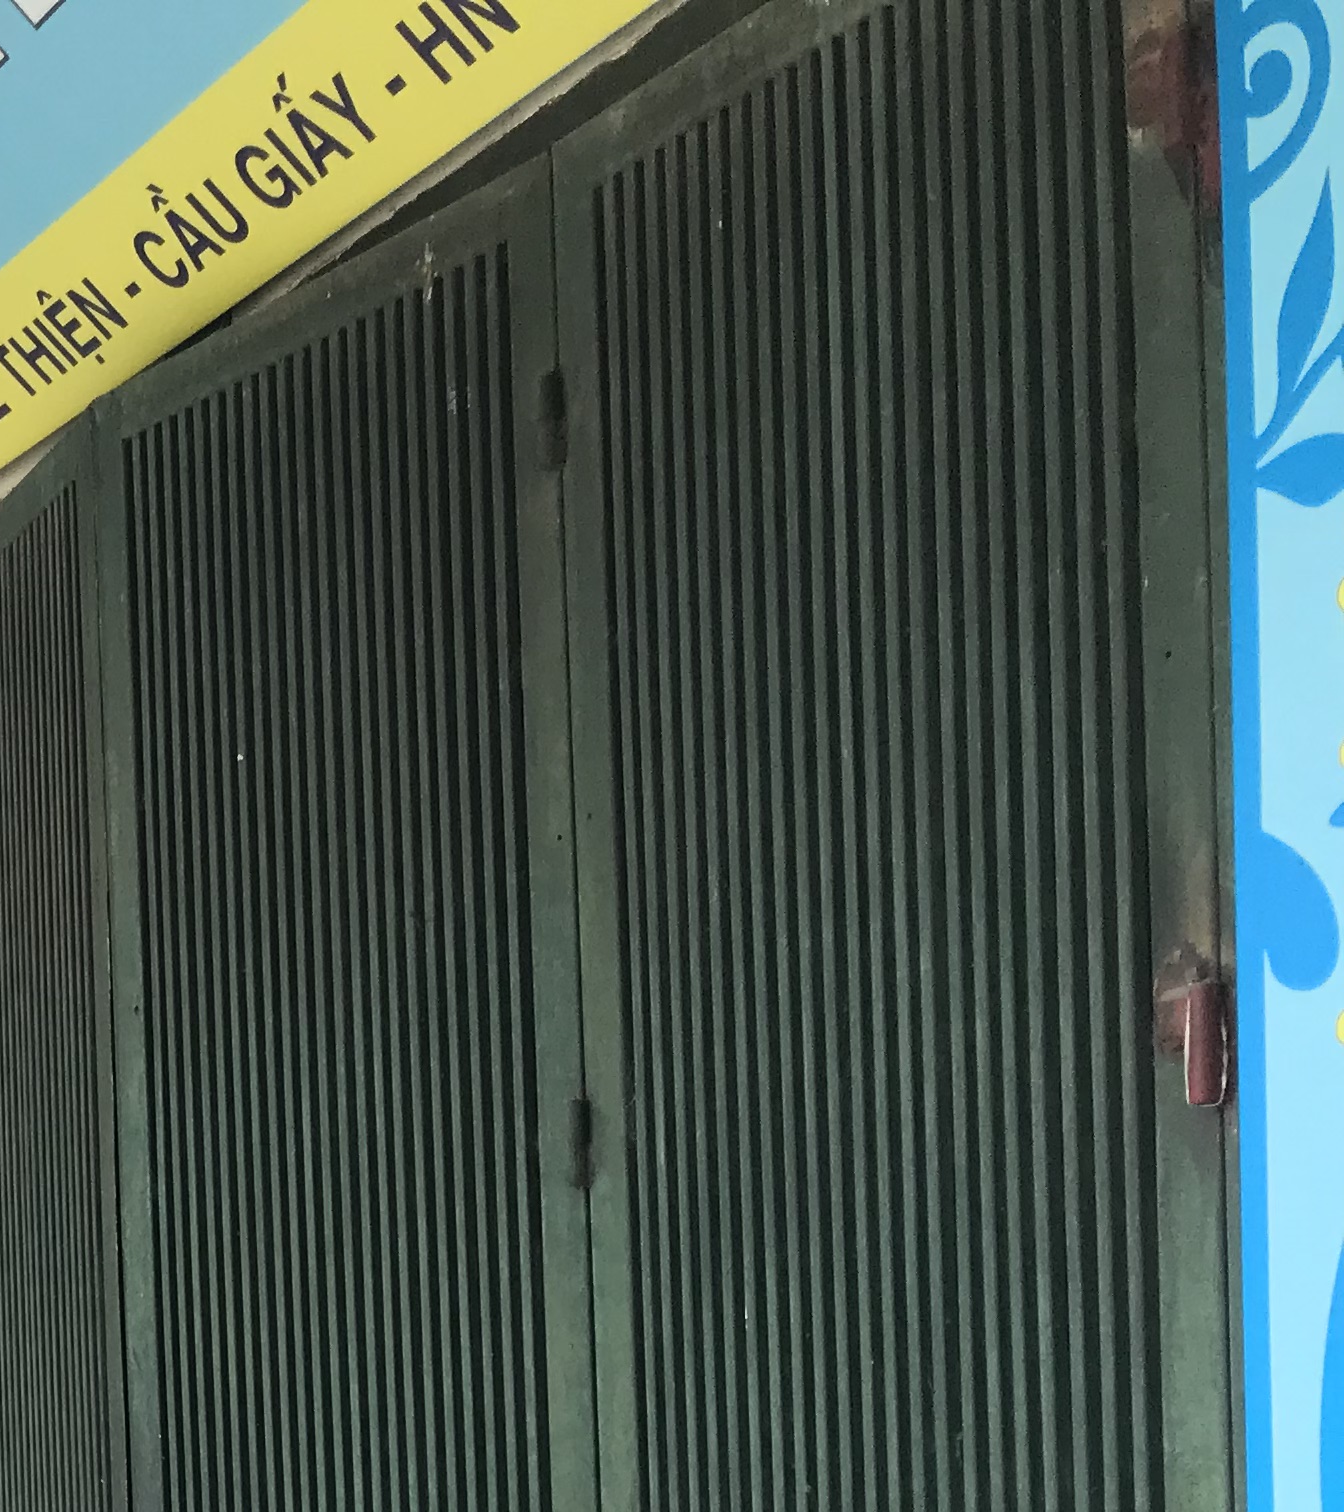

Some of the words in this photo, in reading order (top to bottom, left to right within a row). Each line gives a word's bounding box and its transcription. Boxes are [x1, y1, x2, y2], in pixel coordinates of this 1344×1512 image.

[132, 178, 250, 290] CẦU
[234, 72, 377, 210] GIẤY
[394, 0, 521, 85] HN
